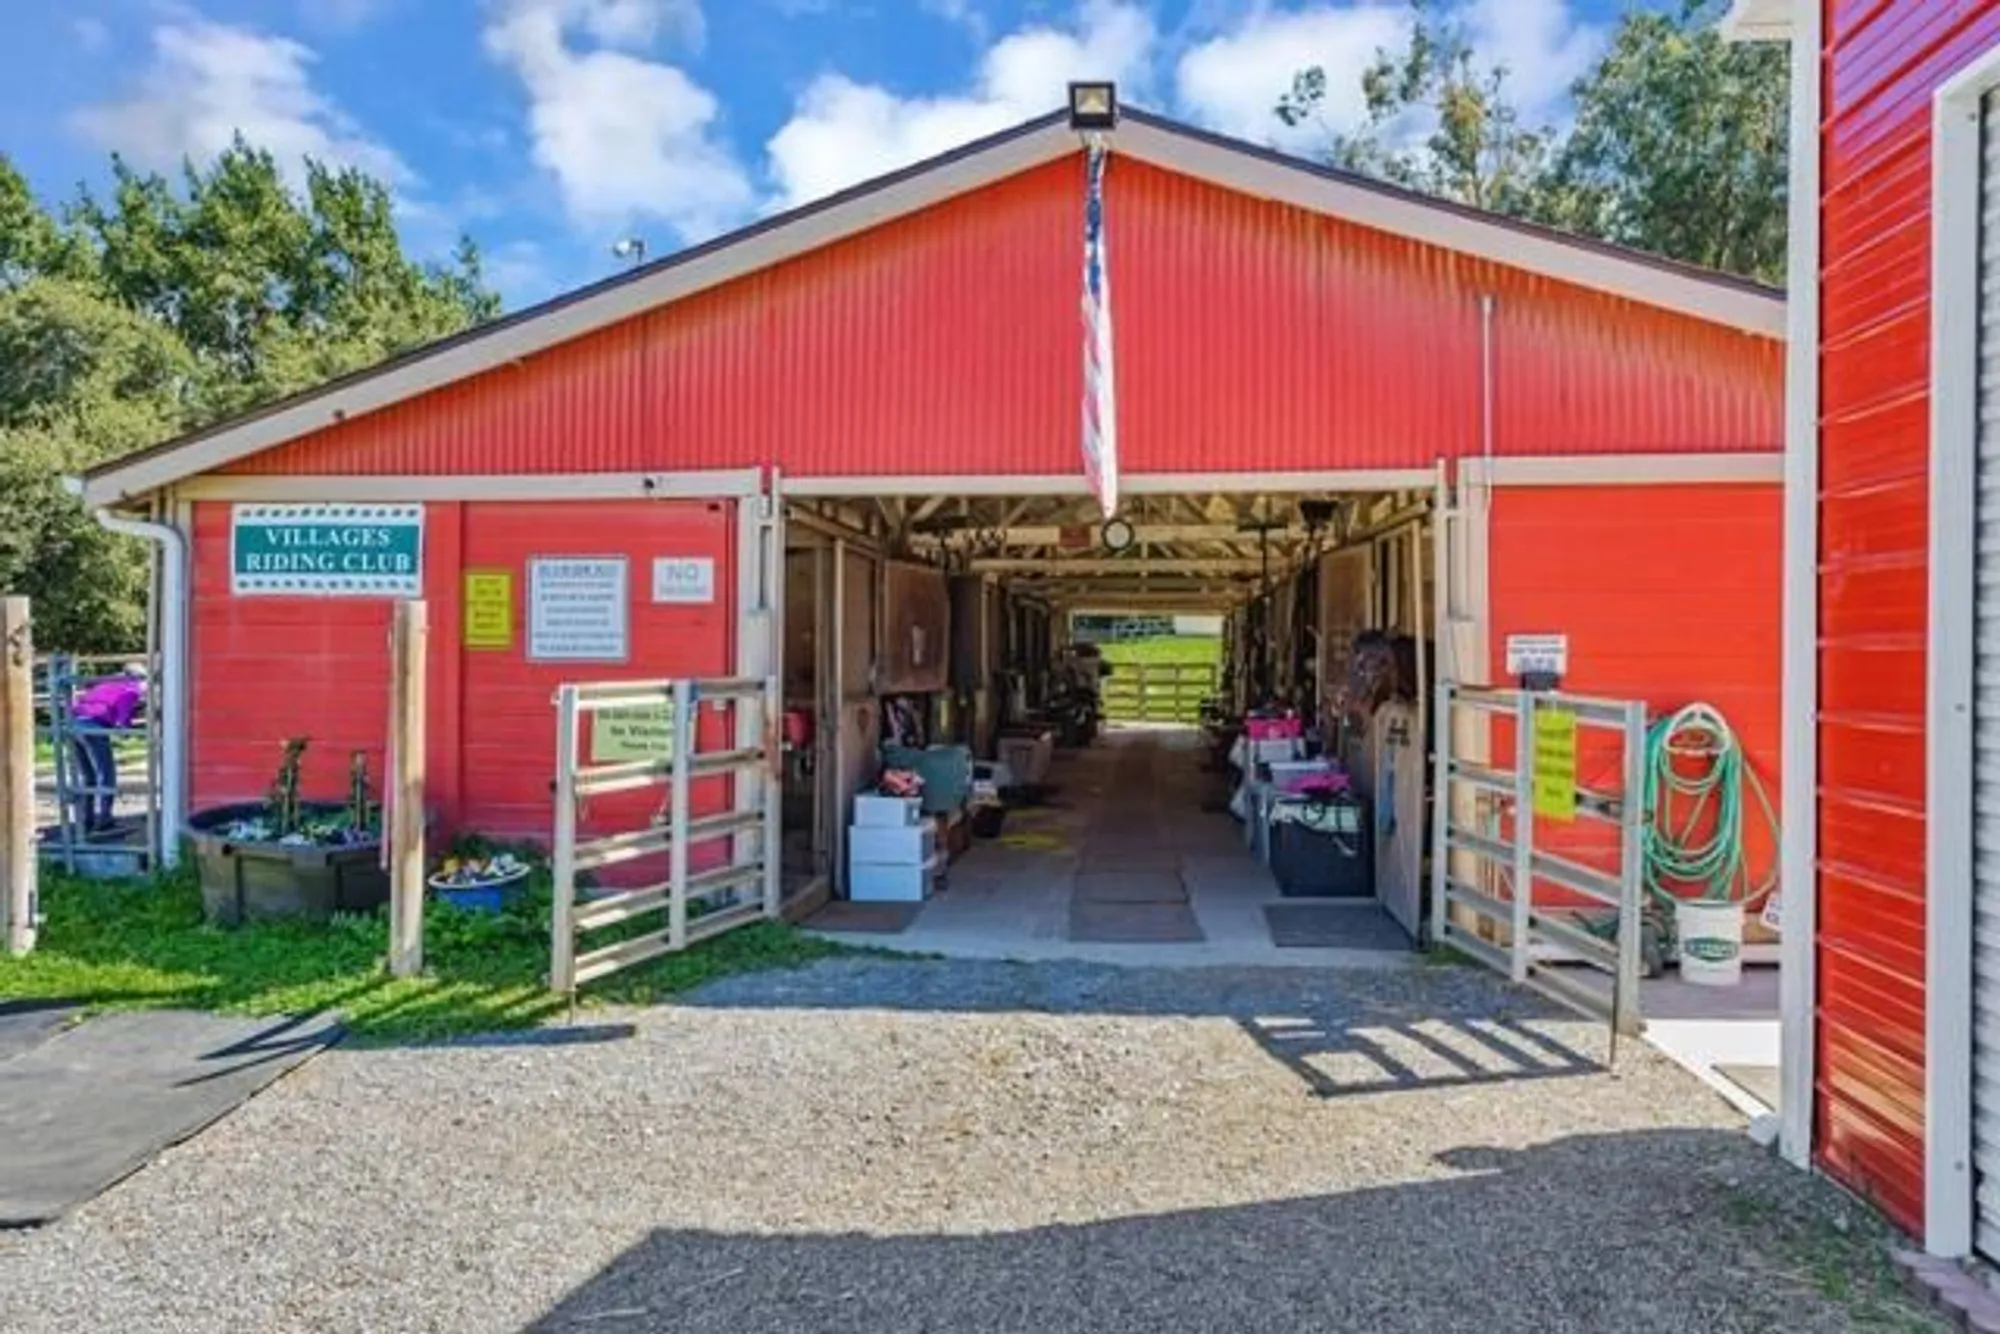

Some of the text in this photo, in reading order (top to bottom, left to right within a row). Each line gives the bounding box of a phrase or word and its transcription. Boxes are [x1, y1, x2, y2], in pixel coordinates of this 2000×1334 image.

[266, 528, 391, 546] VILLAGES
[246, 553, 412, 571] RIDING CLUB
[665, 563, 699, 580] NO
